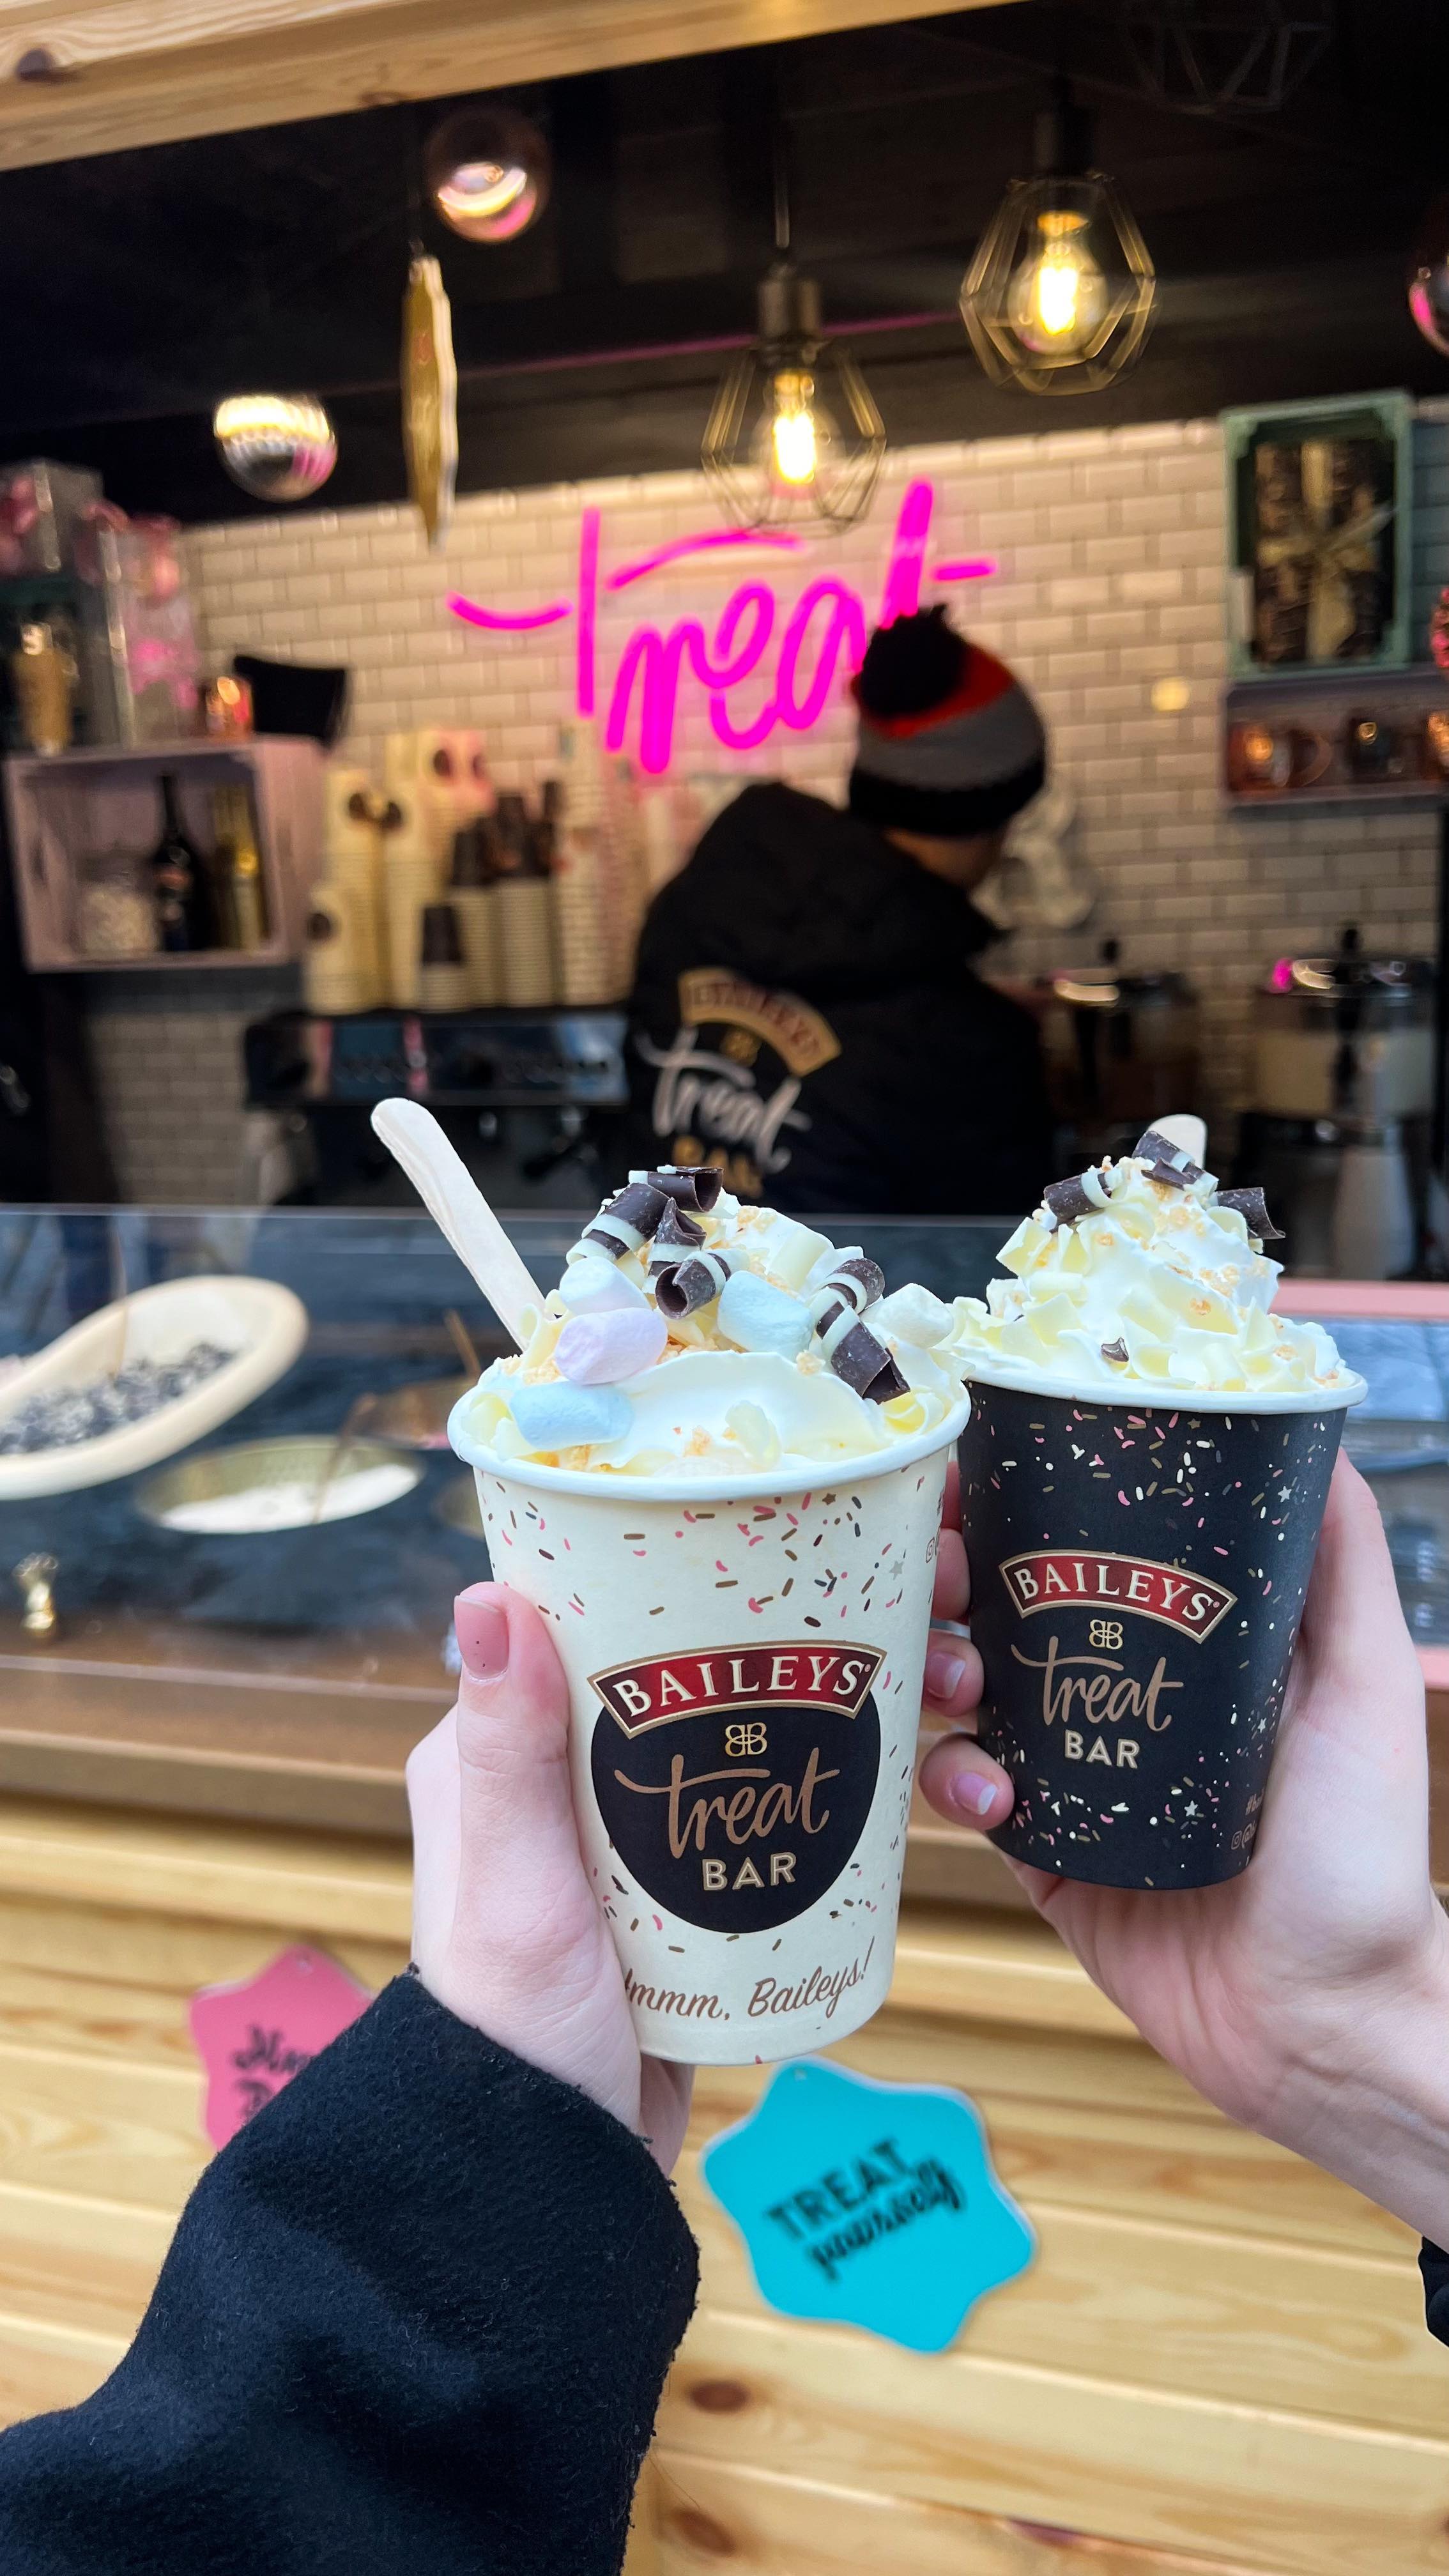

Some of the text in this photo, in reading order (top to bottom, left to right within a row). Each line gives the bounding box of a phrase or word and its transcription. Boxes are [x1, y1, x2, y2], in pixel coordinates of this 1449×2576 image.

[1014, 1562, 1214, 1621] BAILEYS
[612, 1655, 866, 1717] BAILEYS
[1011, 1636, 1184, 1731] treat
[1064, 1729, 1140, 1768] BAR
[614, 1747, 840, 1859] treat
[702, 1851, 796, 1891] BAR
[625, 1936, 875, 2020] mmm, Baileys!
[765, 2137, 910, 2241] TREAT
